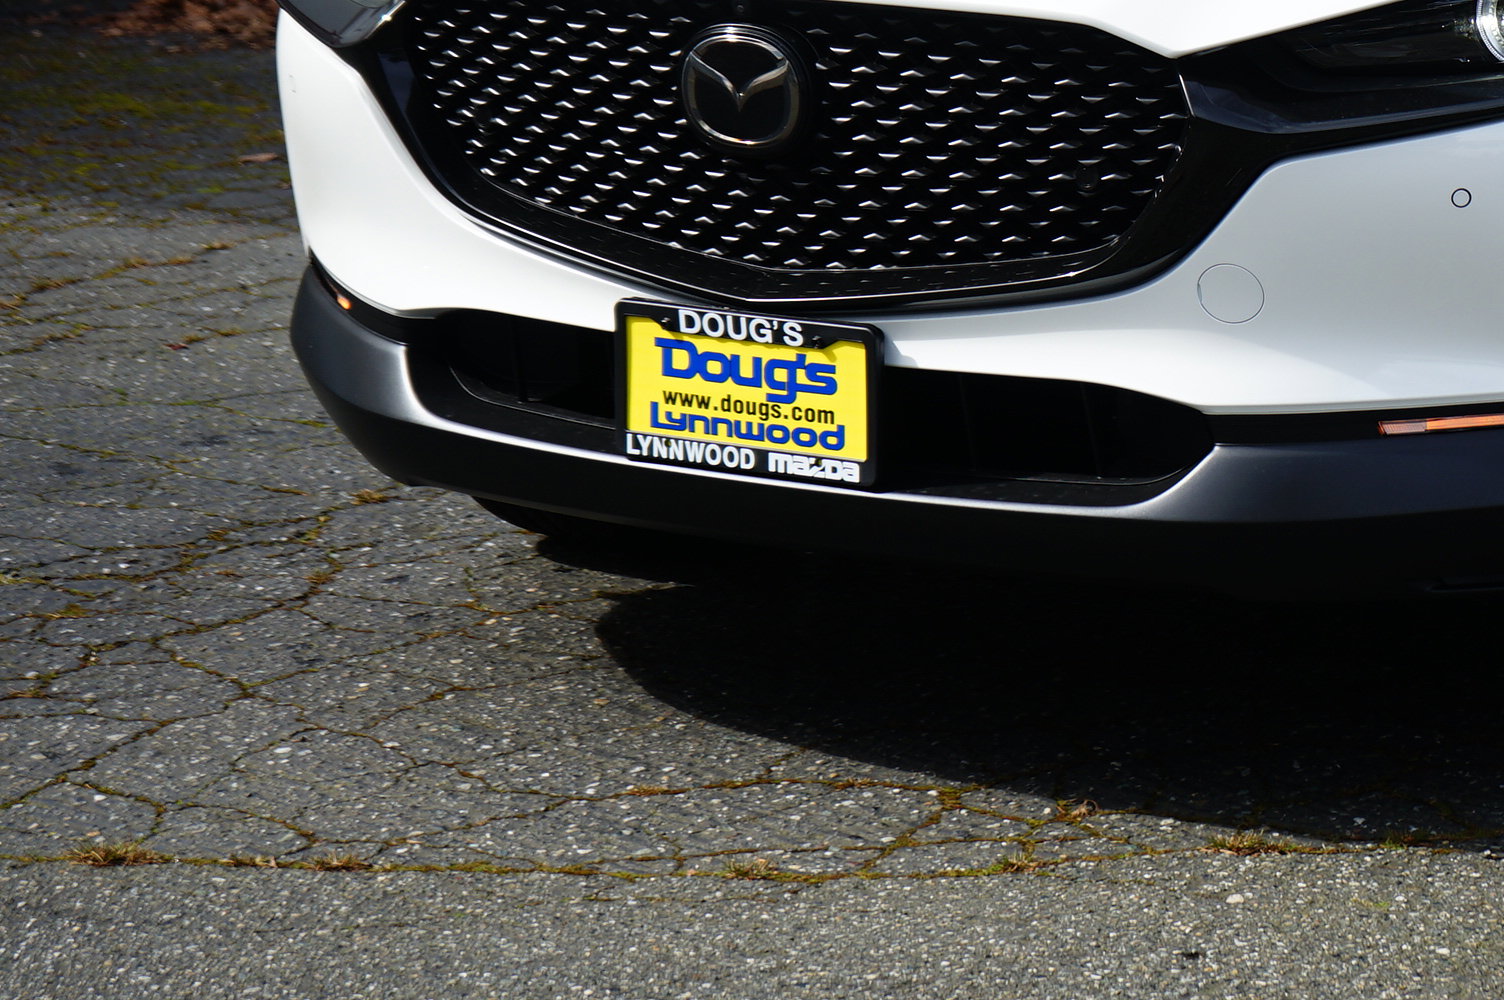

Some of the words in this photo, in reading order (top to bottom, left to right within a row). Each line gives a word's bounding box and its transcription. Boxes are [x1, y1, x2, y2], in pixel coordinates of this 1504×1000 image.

[678, 309, 804, 347] DOUG'S
[654, 337, 838, 404] Doug's
[650, 401, 845, 451] Lynnwood
[662, 390, 835, 424] www.dougs.com
[626, 433, 756, 470] LYNNWOOD
[768, 452, 861, 483] mazda
